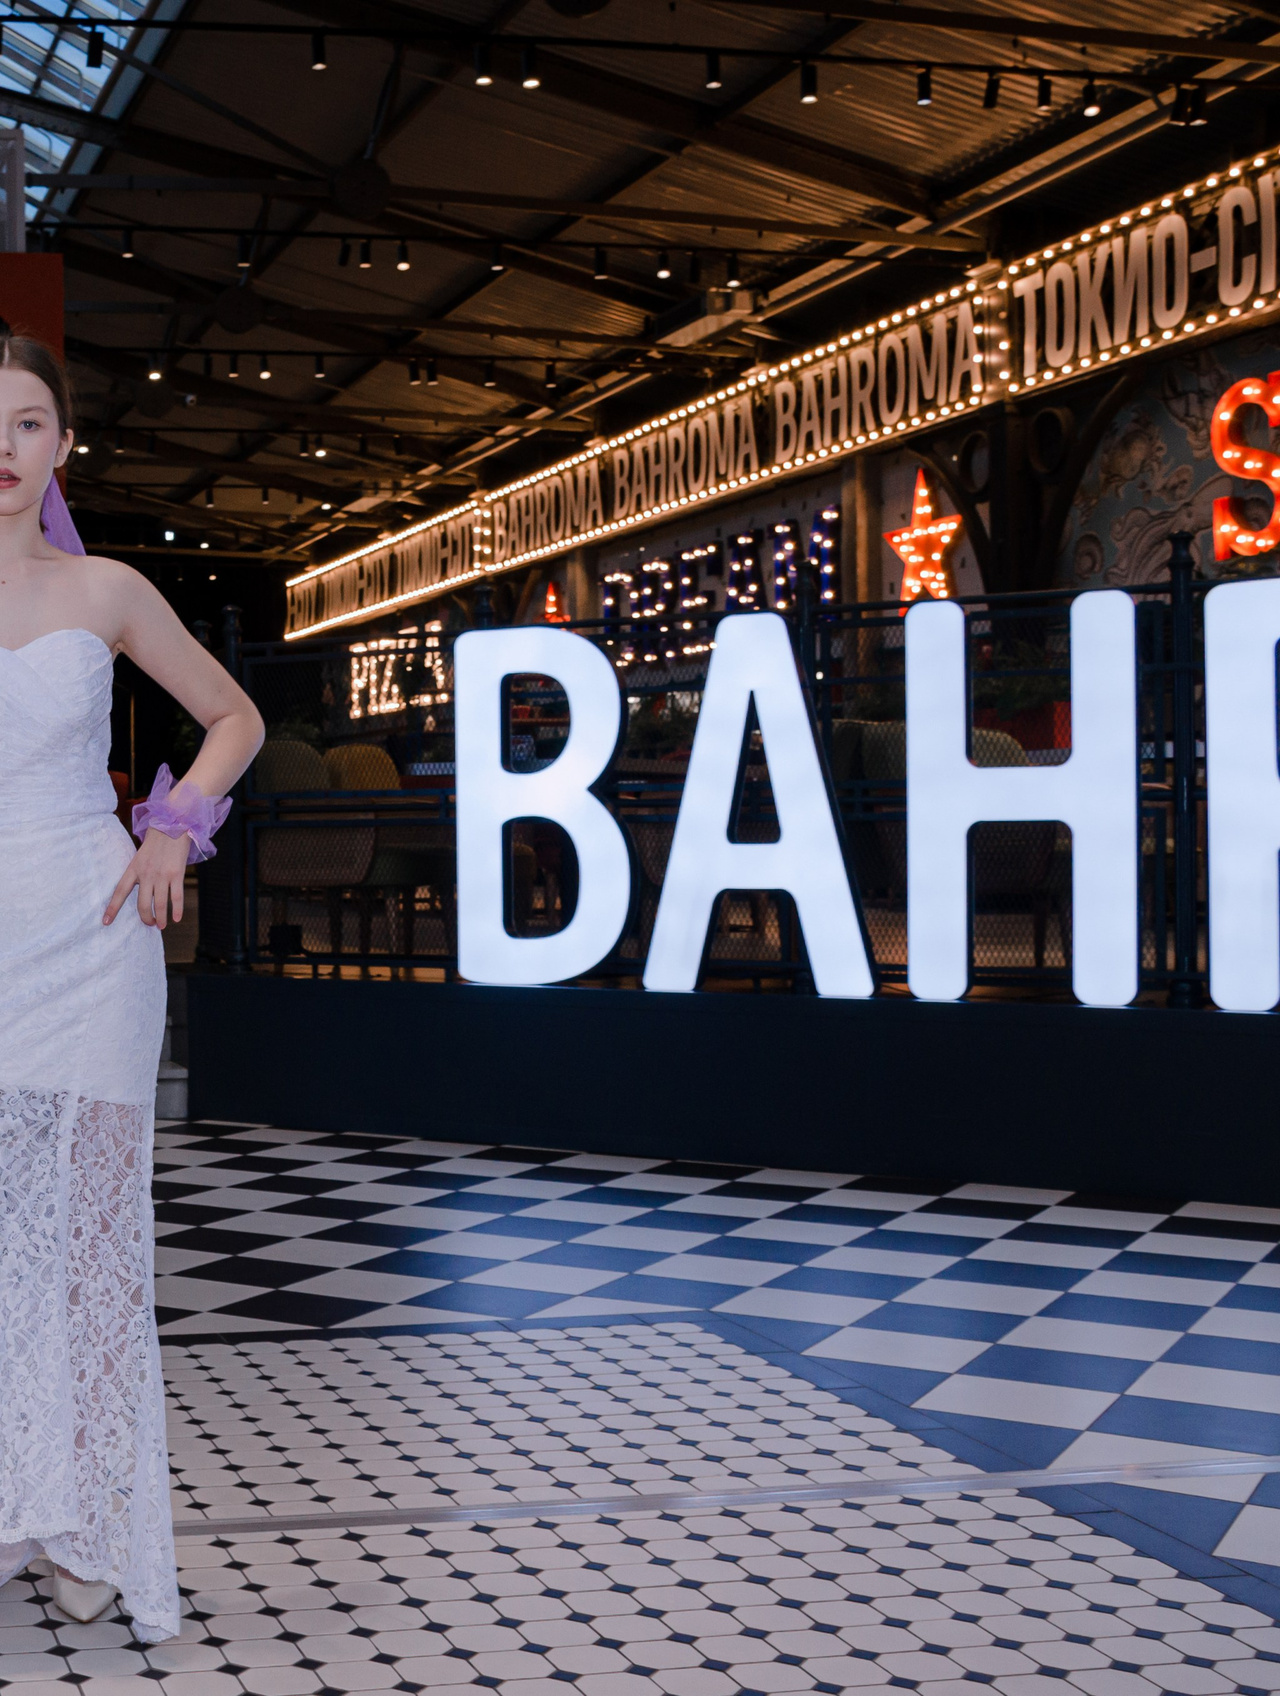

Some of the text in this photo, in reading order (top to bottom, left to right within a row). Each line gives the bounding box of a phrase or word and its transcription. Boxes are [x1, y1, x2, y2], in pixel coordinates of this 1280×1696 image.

[1013, 168, 1280, 377] ТОКИО-CI
[494, 300, 983, 562] BAHROMA BAHROMA BAHROMA
[600, 504, 841, 671] DREAM
